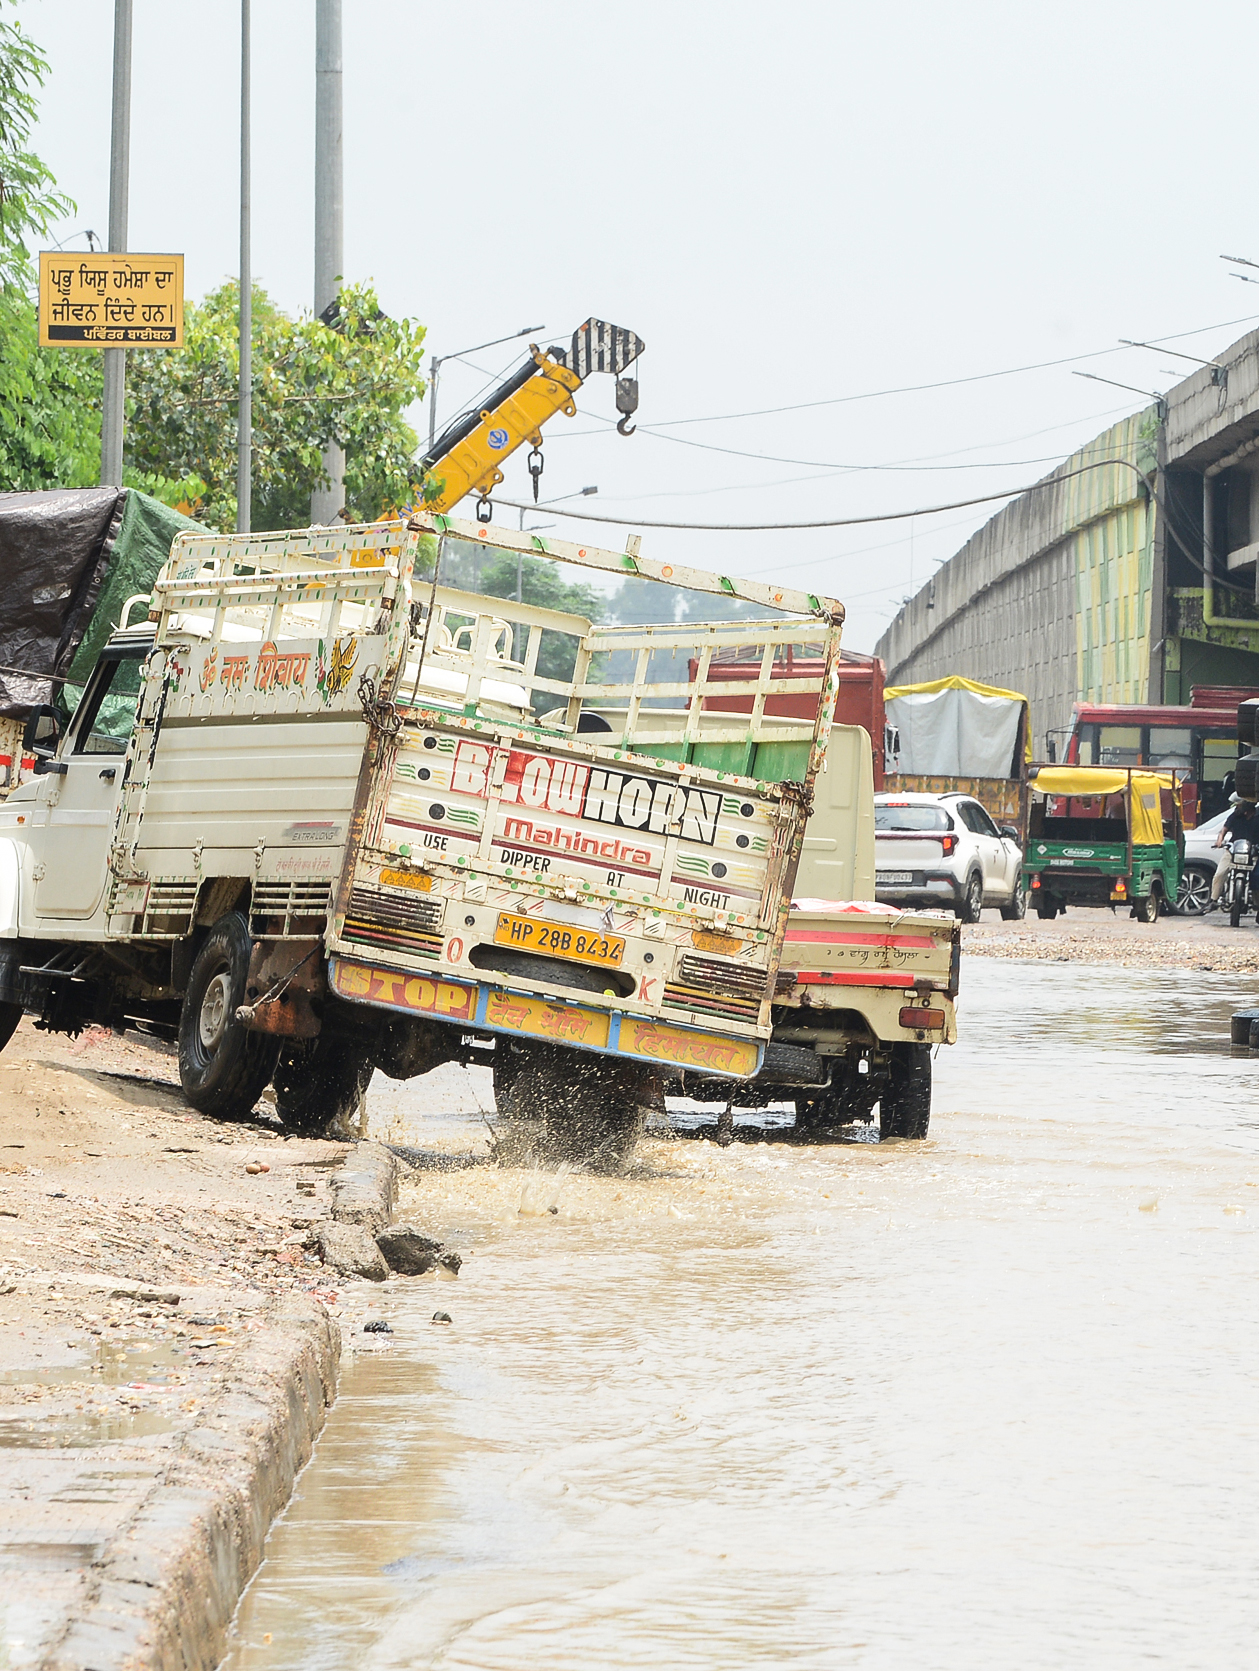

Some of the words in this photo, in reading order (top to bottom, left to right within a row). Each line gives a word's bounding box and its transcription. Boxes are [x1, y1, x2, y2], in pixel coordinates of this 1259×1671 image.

[51, 270, 74, 295] ਪ੍ਰਭੂ
[79, 263, 109, 296] ਯਿਸੂ
[113, 264, 151, 289] ਹਮੇਸ਼ਾ
[155, 272, 174, 289] ਦਾ
[52, 297, 99, 321] ਜੀਵਨ
[104, 297, 137, 322] ਦਿੰਦੇ
[83, 326, 126, 340] ਪਵਿੱਤਰ
[127, 328, 173, 340] ਬਾਈਬਲ
[254, 641, 312, 695] शिवाय
[450, 739, 590, 818] BLOW
[582, 767, 722, 846] HORN
[423, 834, 449, 851] USE
[500, 850, 551, 873] DIPPER
[606, 871, 626, 888] AT
[684, 887, 731, 909] NIGHT
[511, 921, 533, 942] HP
[538, 928, 572, 950] 28B
[576, 935, 621, 961] 8434
[339, 965, 468, 1012] STOP
[638, 975, 657, 1002] K
[489, 992, 532, 1028] देव
[633, 1023, 741, 1069] हिमाचल
